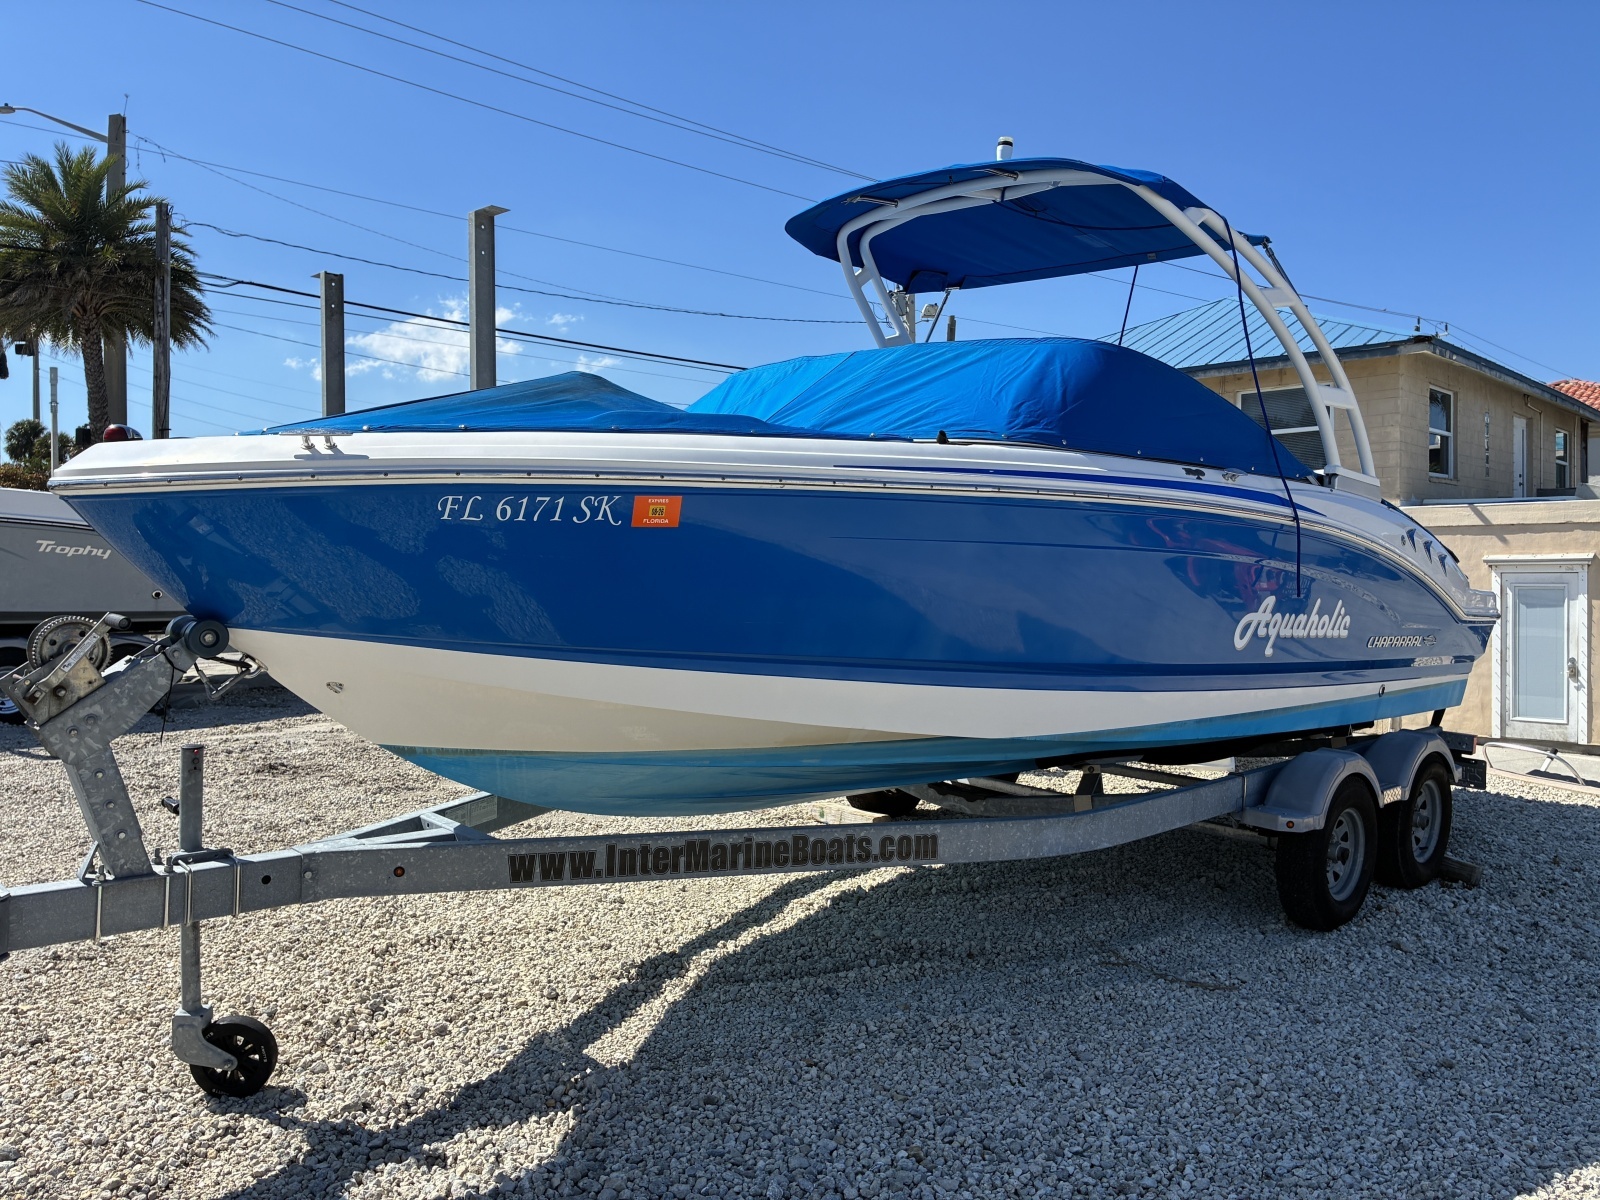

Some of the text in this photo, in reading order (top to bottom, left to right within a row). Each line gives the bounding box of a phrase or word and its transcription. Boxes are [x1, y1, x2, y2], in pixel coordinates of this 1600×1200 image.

[437, 495, 622, 526] FL 6171 SK
[36, 539, 112, 560] Trophy
[1233, 595, 1351, 658] Aquaholic
[1366, 635, 1423, 649] CHAPARRAL
[507, 832, 940, 884] www.InterMarineBoats.com
